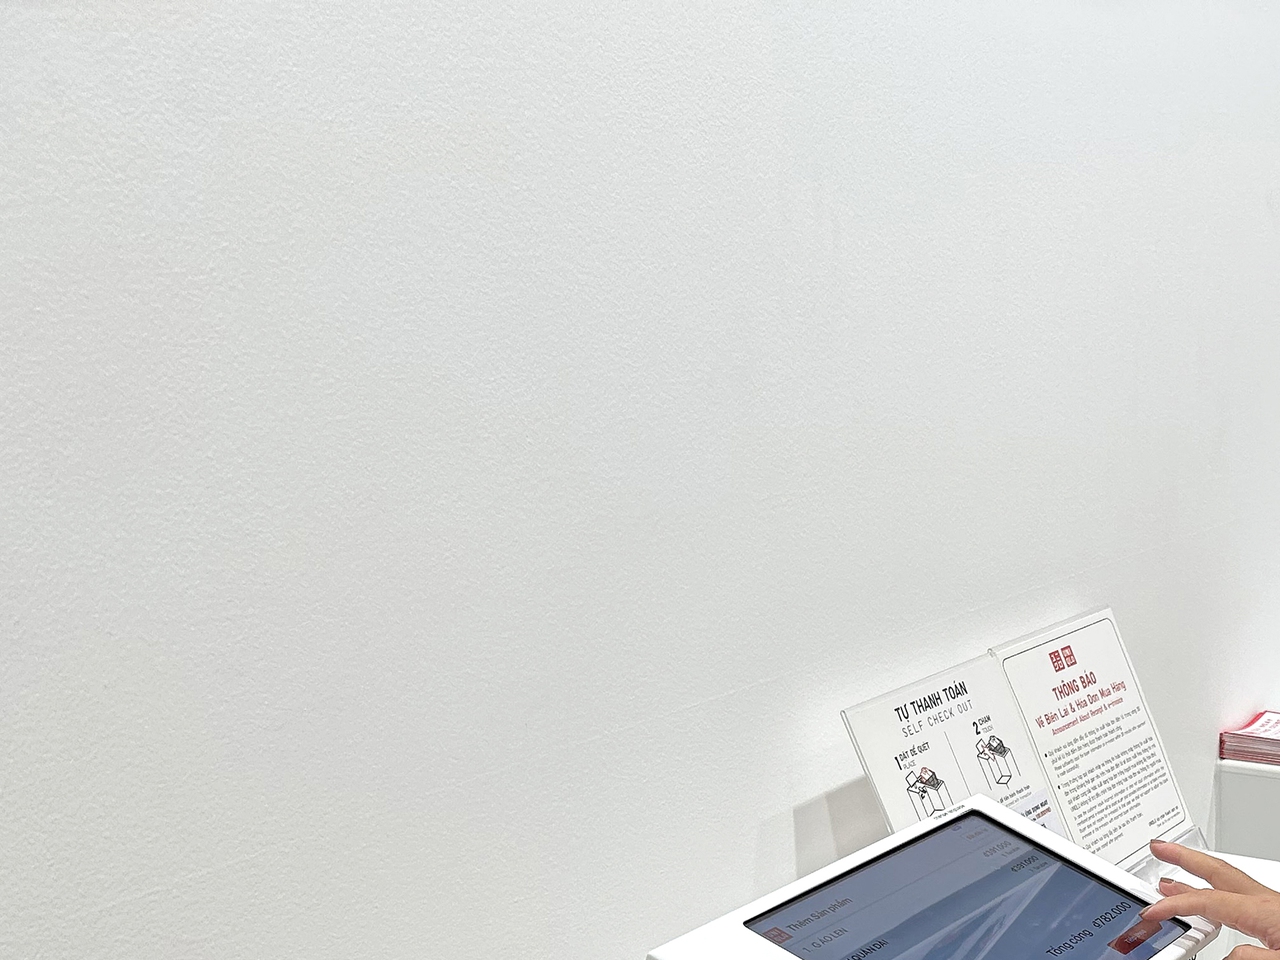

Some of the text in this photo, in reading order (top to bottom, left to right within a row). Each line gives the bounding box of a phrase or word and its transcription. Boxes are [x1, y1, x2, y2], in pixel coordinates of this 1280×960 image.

[1052, 670, 1096, 701] THÔNG BÁO
[910, 692, 943, 717] THANH
[942, 680, 968, 702] TOÁN
[901, 700, 974, 738] SELF CHECK OUT
[1058, 704, 1069, 718] Lai
[1069, 702, 1076, 713] &
[971, 720, 981, 735] 2
[894, 755, 902, 771] 1
[786, 917, 812, 932] Thêm
[1046, 942, 1074, 957] Tổng
[1069, 929, 1094, 944] cộng
